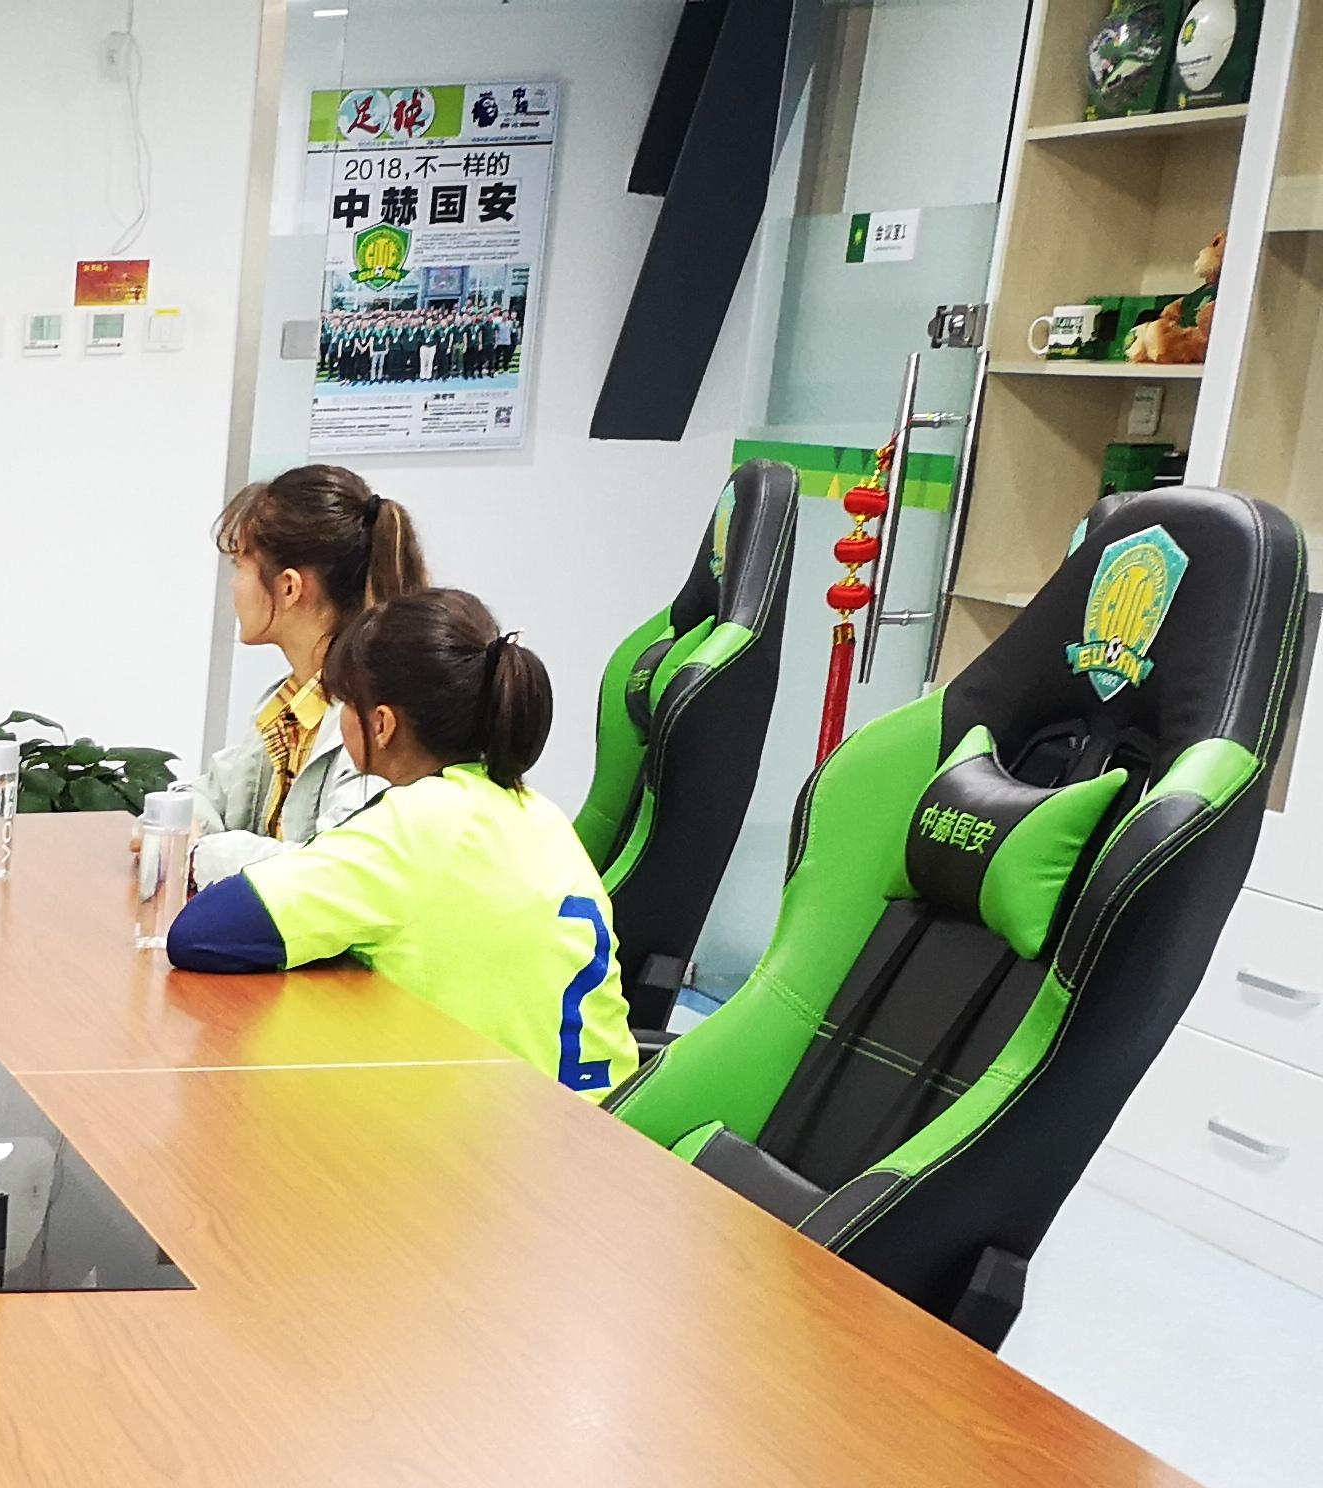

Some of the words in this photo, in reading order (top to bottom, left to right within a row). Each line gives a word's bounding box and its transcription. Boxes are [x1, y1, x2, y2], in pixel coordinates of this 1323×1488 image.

[347, 87, 426, 138] 足球
[344, 152, 510, 181] 2018,不一样的
[332, 182, 517, 228] 中赫国安
[919, 802, 997, 854] 中赫国安
[558, 895, 612, 1091] 2
